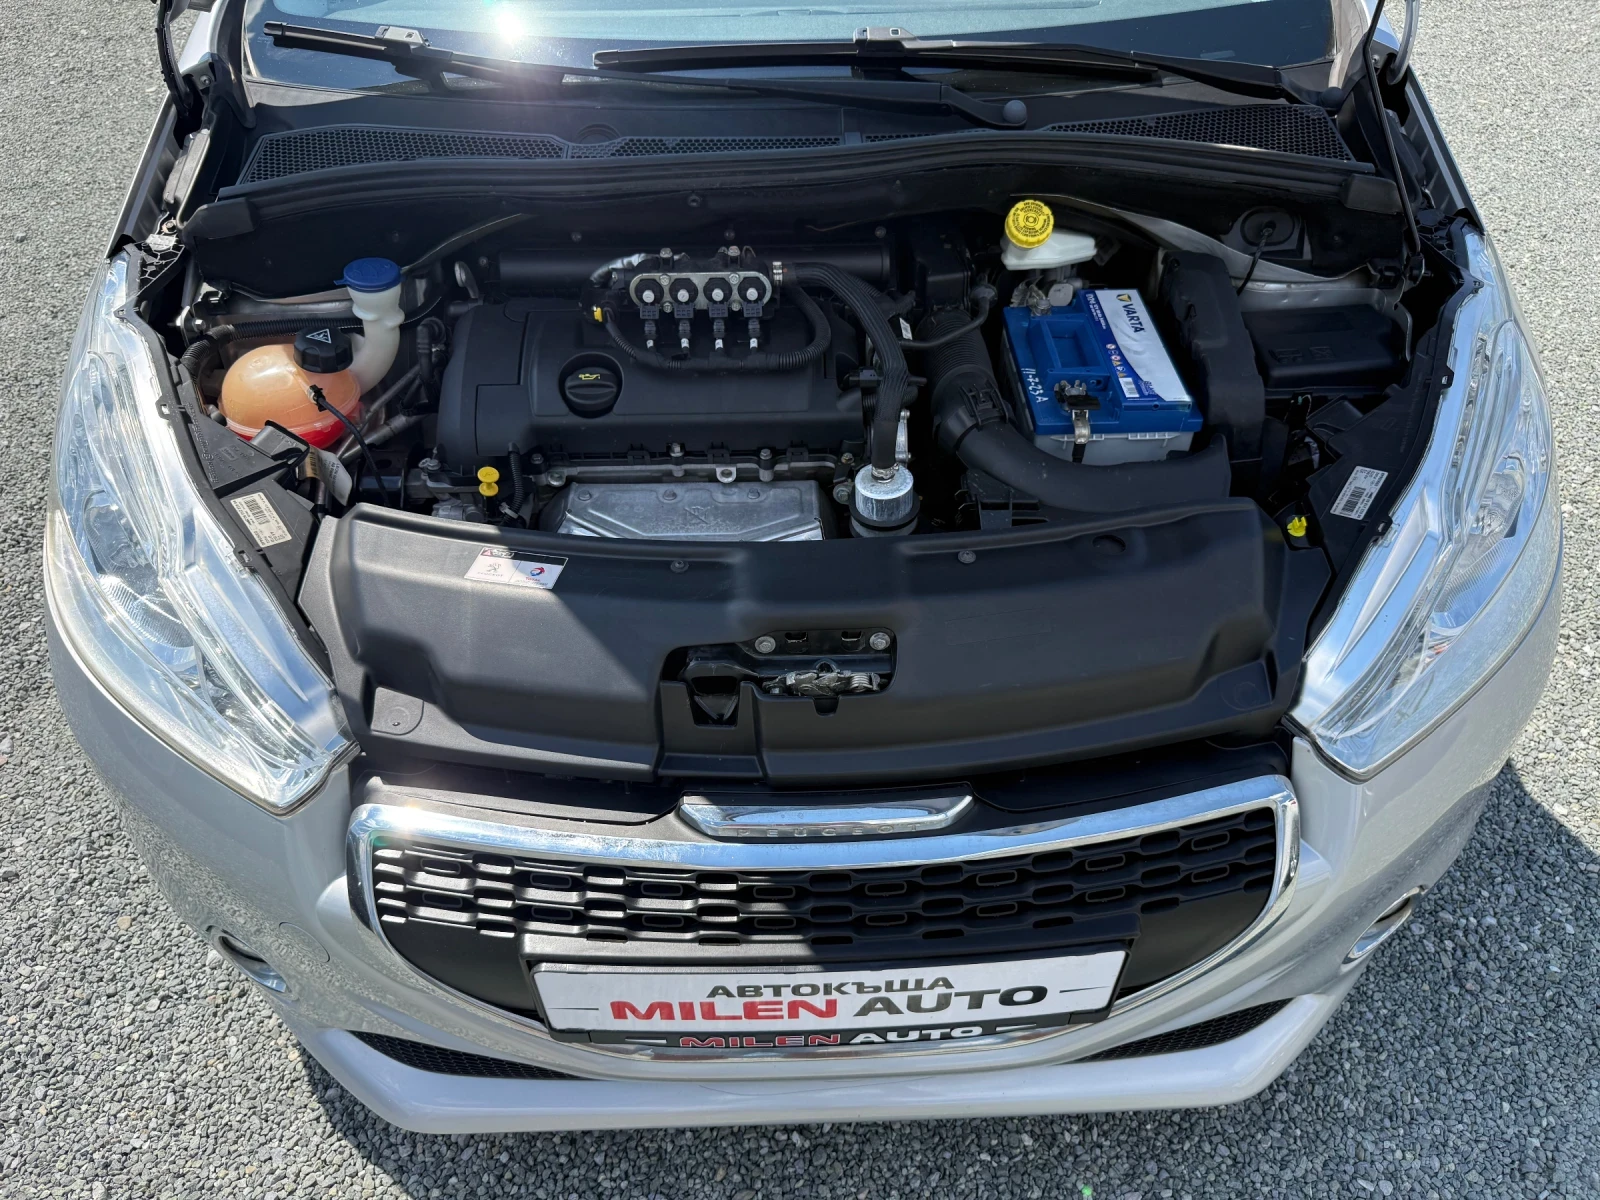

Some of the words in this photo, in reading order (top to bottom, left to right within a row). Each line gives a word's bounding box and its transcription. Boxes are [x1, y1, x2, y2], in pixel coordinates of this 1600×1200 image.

[1122, 303, 1145, 333] VARTA
[736, 823, 922, 838] PEUGEOT
[609, 998, 838, 1022] MILEN
[852, 984, 1048, 1018] AUTO
[678, 1033, 840, 1049] MILEN
[849, 1025, 983, 1045] AUTO
